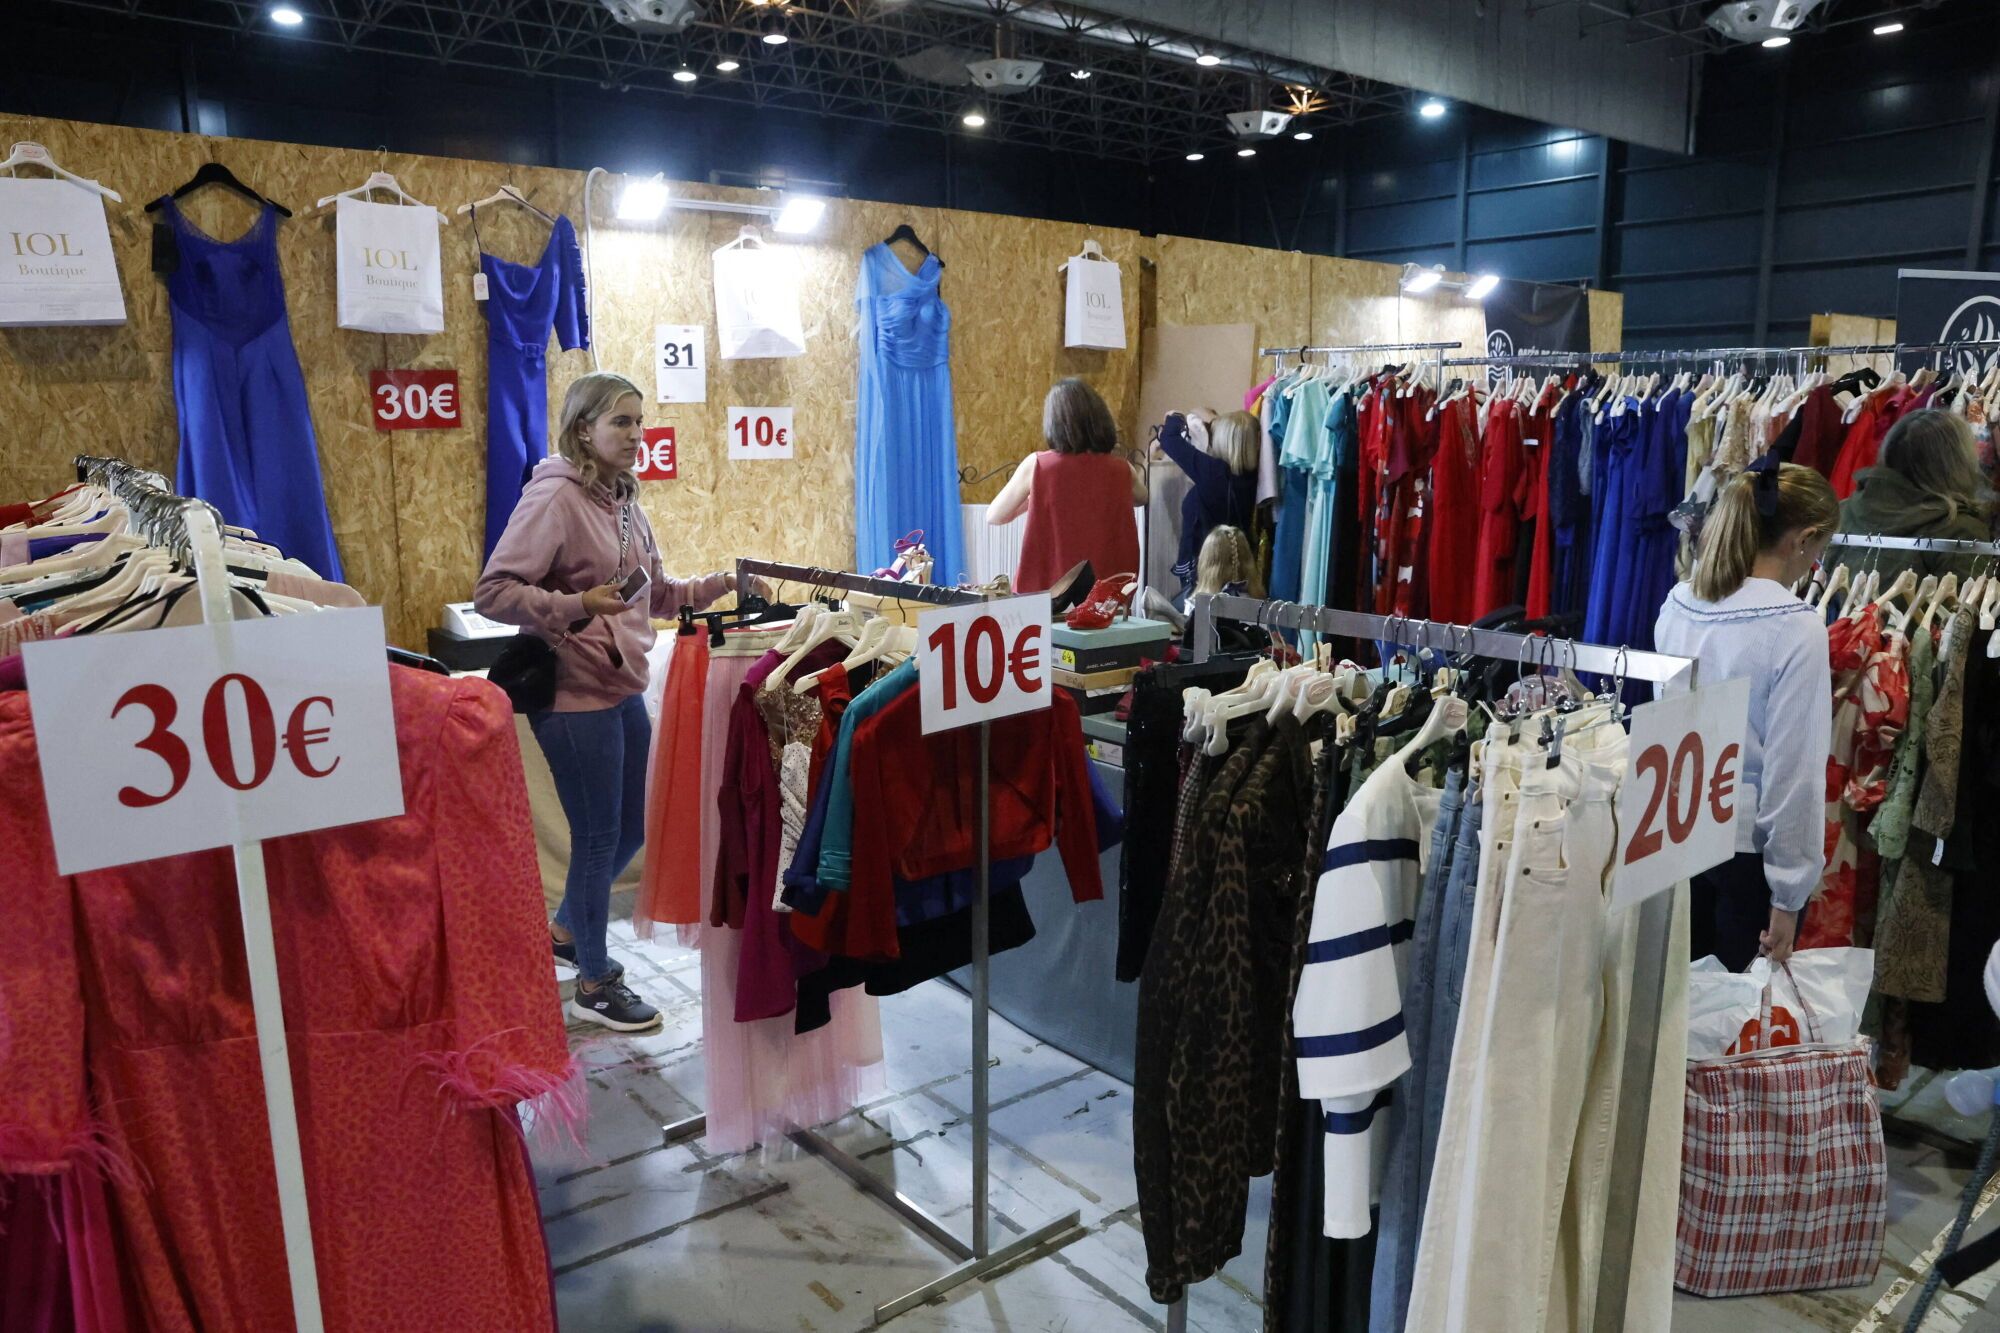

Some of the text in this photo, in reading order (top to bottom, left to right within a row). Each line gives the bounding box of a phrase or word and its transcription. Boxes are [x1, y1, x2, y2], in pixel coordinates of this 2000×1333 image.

[9, 231, 84, 257] IOL
[363, 247, 418, 272] IOL
[18, 263, 87, 279] Boutique
[365, 275, 419, 290] Boutique
[663, 342, 694, 367] 31
[376, 383, 457, 421] 30€
[734, 415, 788, 447] 10€
[633, 438, 673, 473] 0€
[927, 615, 1043, 711] 10€
[110, 672, 341, 808] 30€
[1624, 731, 1740, 866] 20€
